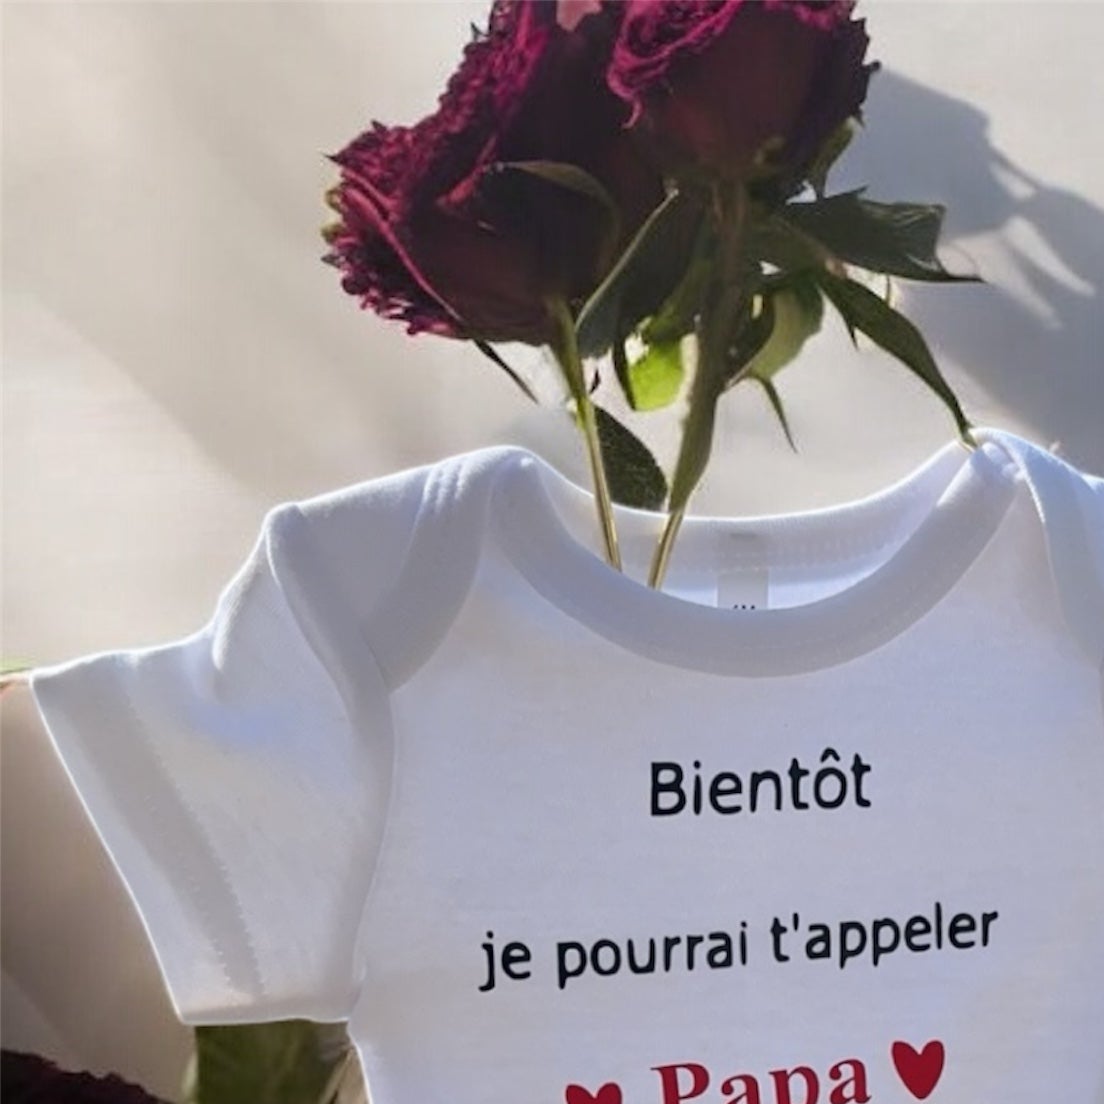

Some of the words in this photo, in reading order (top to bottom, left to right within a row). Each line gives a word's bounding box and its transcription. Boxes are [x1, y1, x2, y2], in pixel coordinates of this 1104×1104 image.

[650, 746, 872, 817] Bientôt
[477, 930, 532, 993] je
[556, 920, 748, 991] pourrai
[769, 901, 1000, 970] t'appeler
